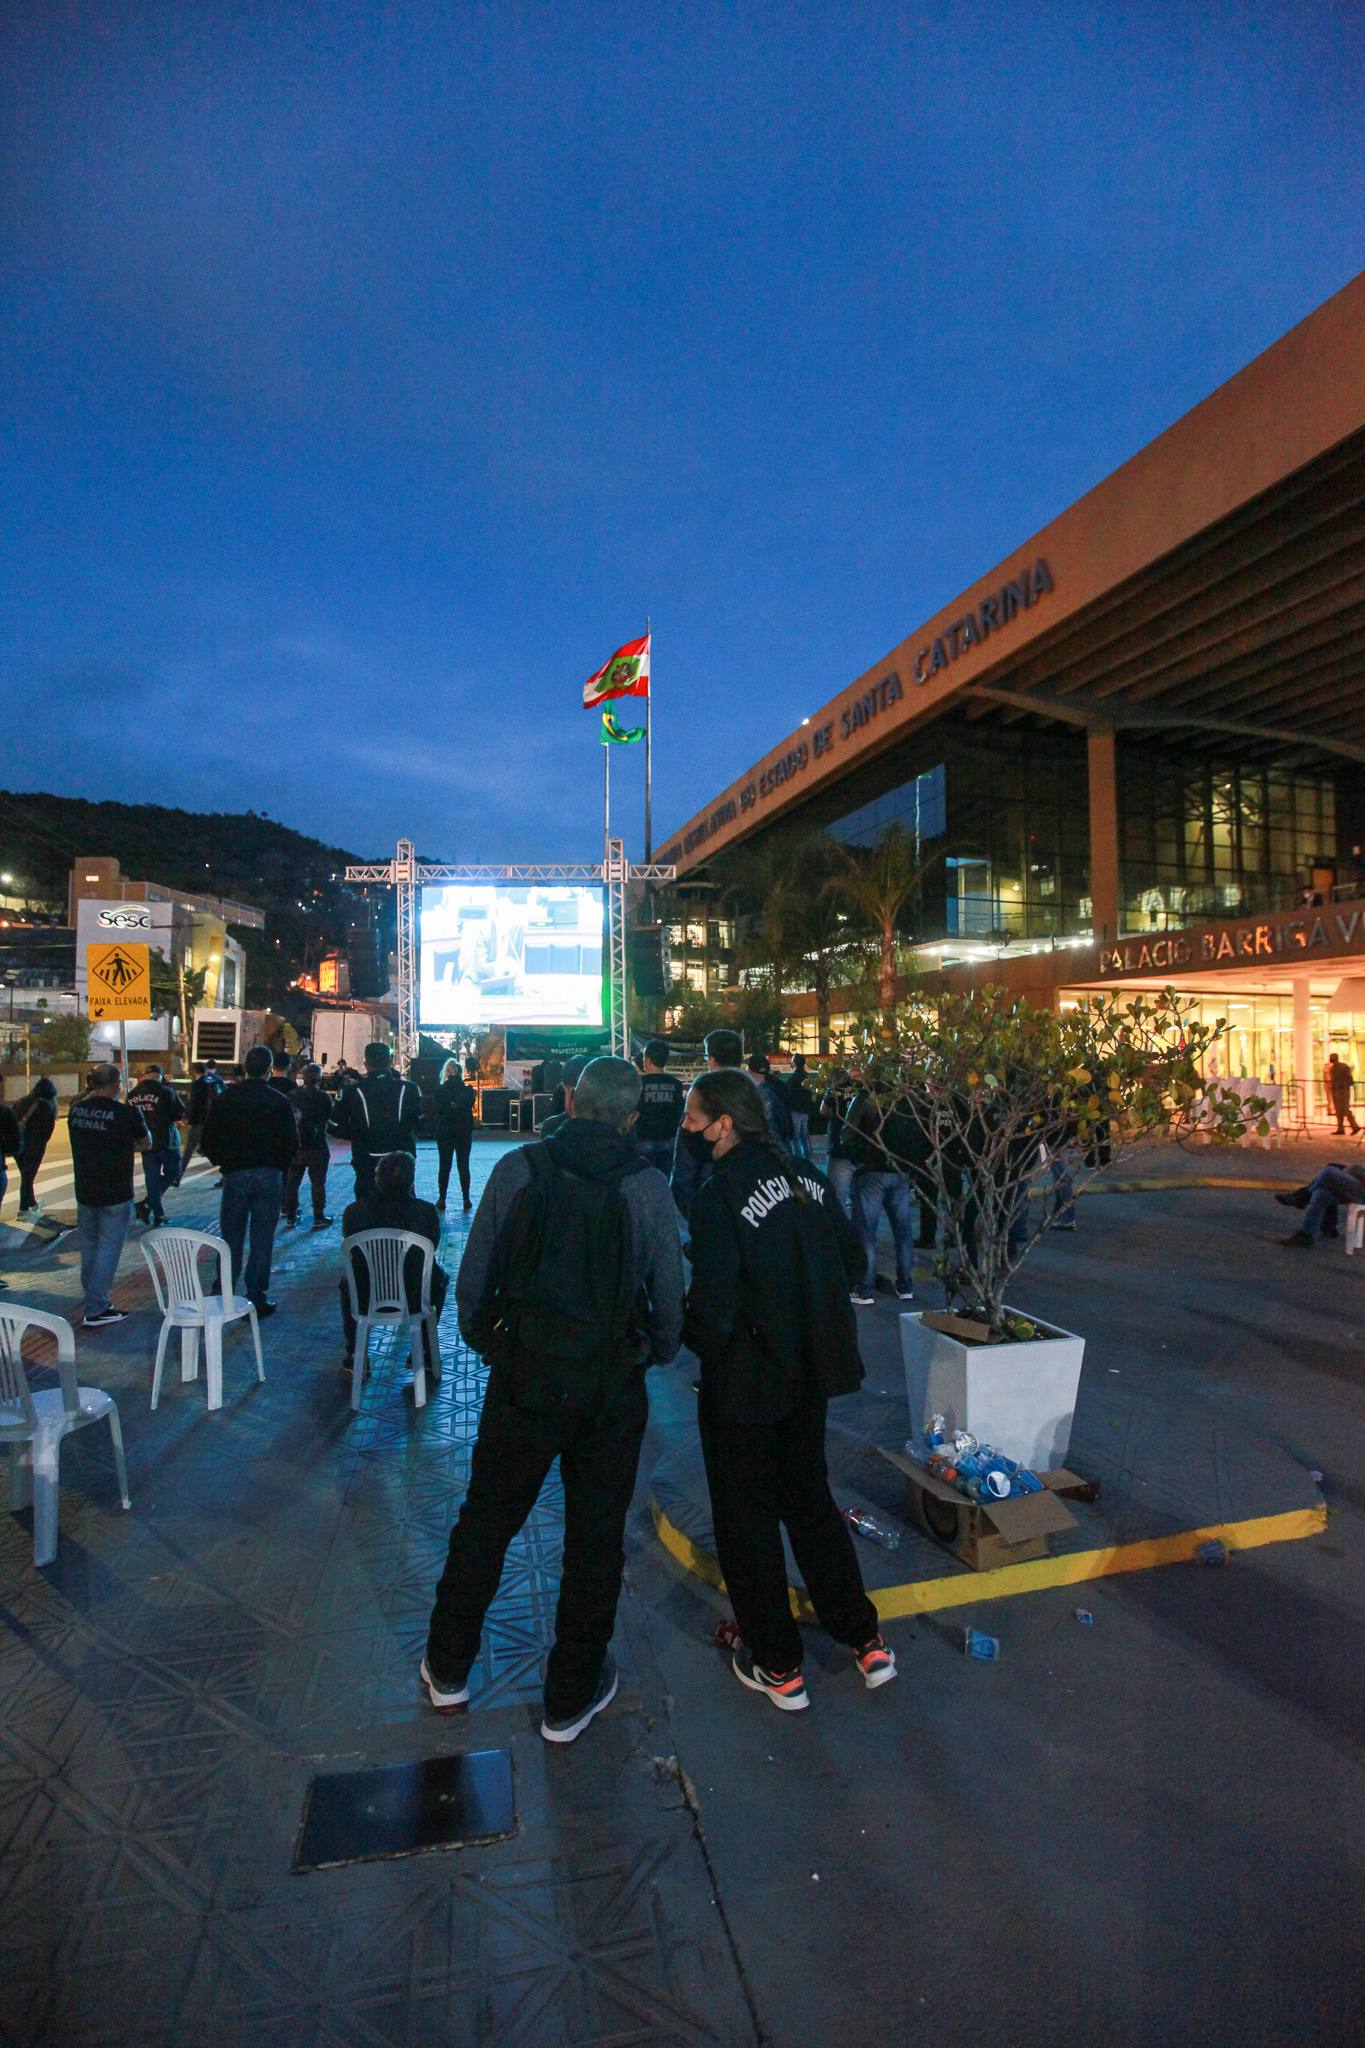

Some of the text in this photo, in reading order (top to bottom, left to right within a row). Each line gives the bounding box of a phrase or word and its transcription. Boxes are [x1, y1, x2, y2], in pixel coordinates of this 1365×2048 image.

[757, 741, 808, 798] ESTADO
[812, 719, 834, 760] DE
[839, 671, 903, 740] SANTA
[912, 557, 1055, 686] CATARINA
[1201, 917, 1330, 961] BARRIGA
[90, 996, 149, 1006] FAIXA ELEVADA
[644, 1091, 674, 1103] PENAL
[71, 1117, 107, 1131] PENAL
[740, 1175, 795, 1228] POLÍCIA
